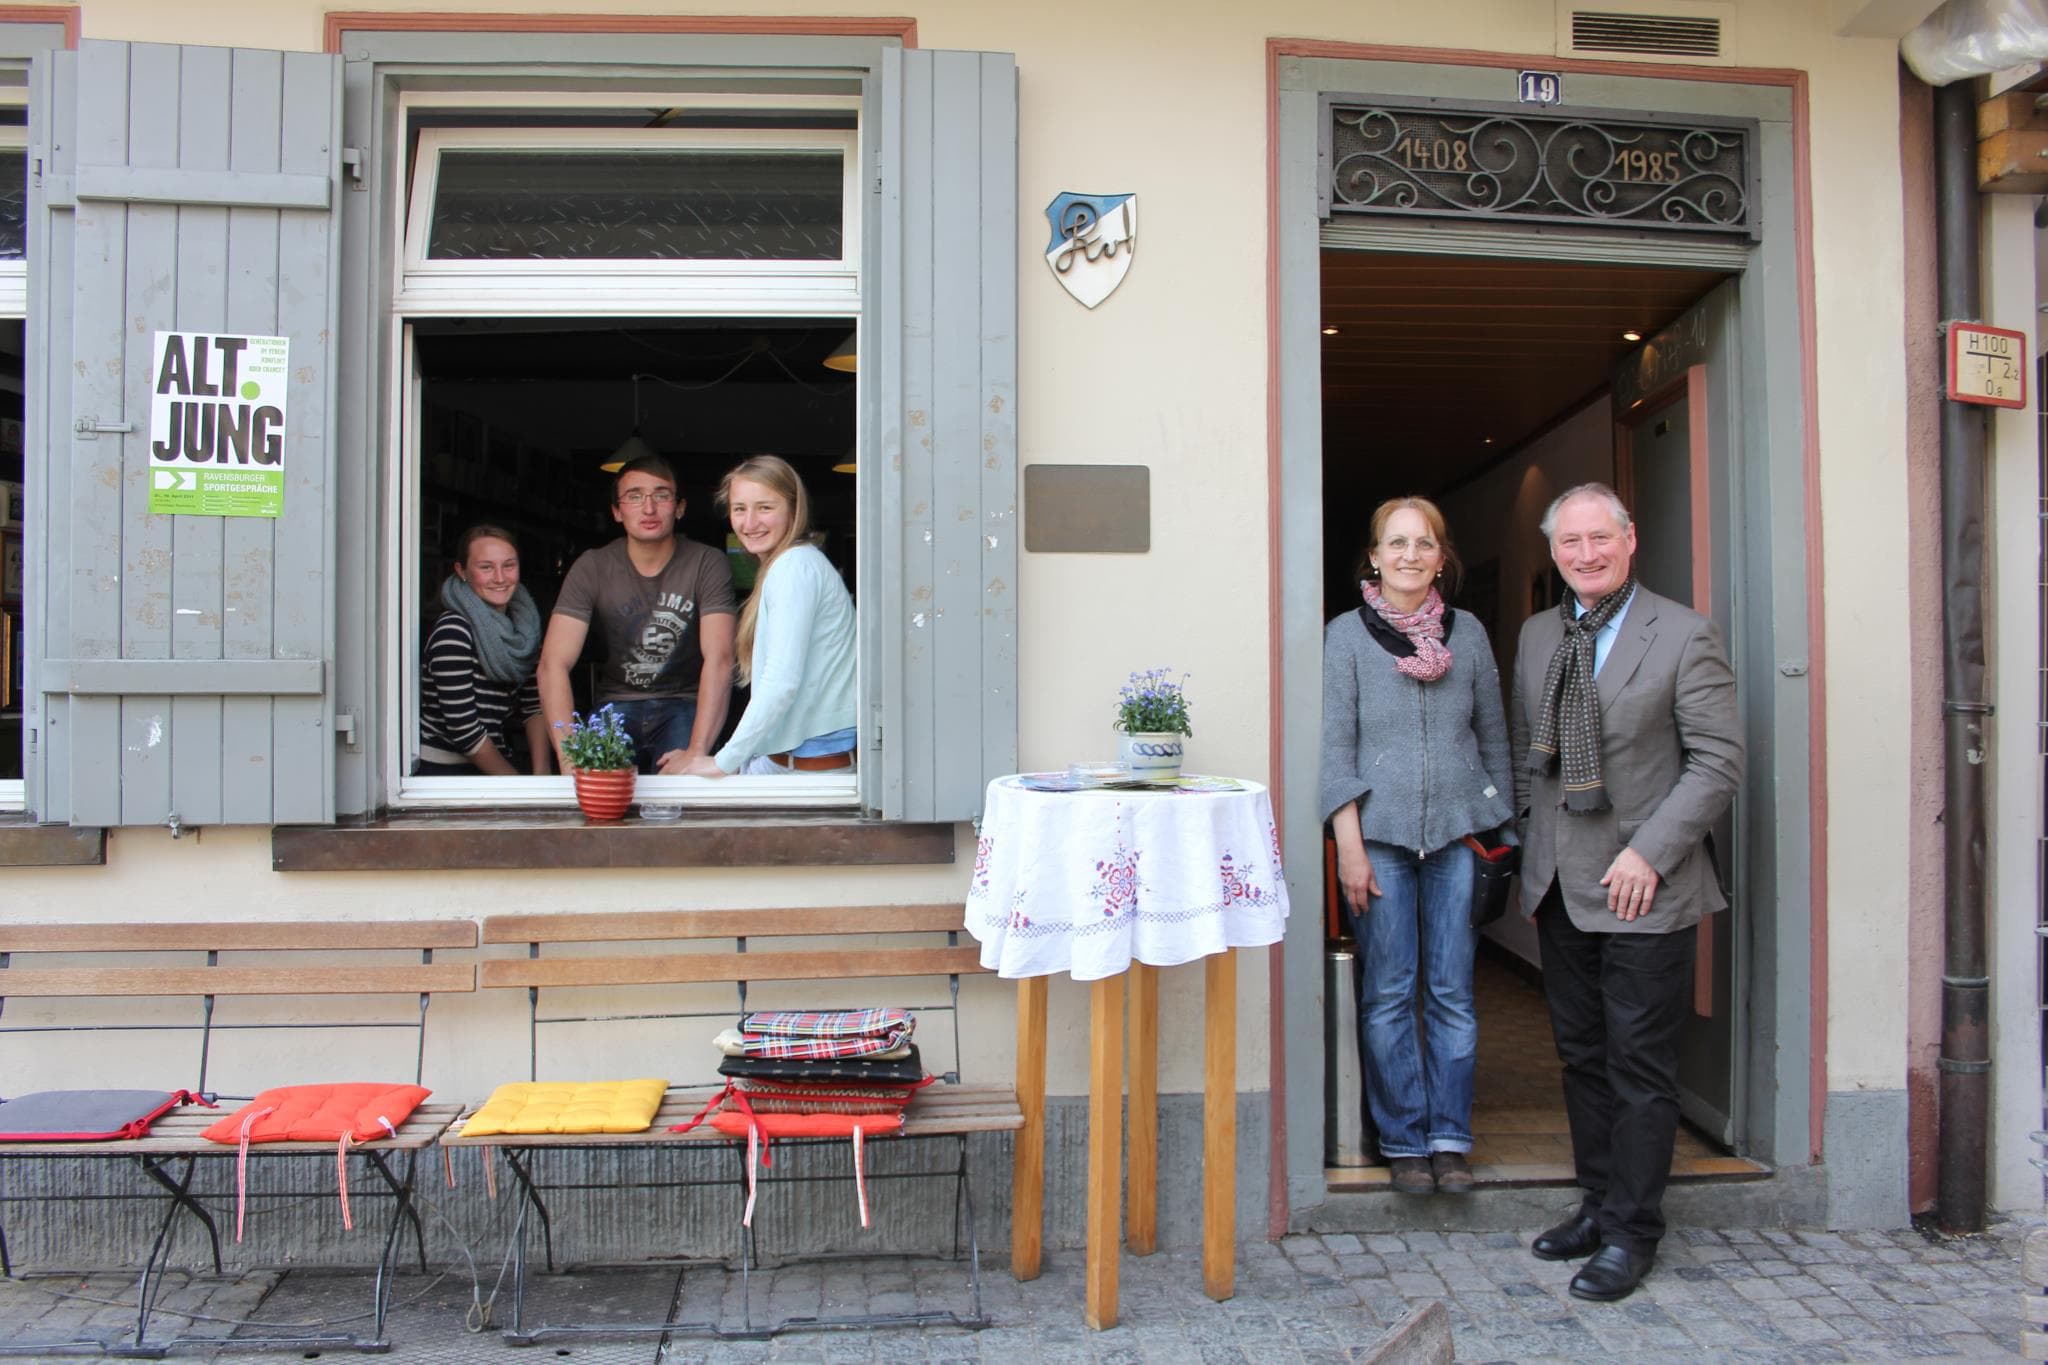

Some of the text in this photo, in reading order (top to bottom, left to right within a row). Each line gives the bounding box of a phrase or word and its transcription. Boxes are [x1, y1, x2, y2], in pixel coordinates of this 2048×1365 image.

[1525, 75, 1555, 102] 19
[1398, 137, 1467, 171] 1408
[1615, 150, 1680, 183] 1985
[153, 402, 283, 465] JUNG
[203, 472, 266, 482] RAVENSBURGER
[203, 482, 279, 493] SPORTGESPRÄCHE
